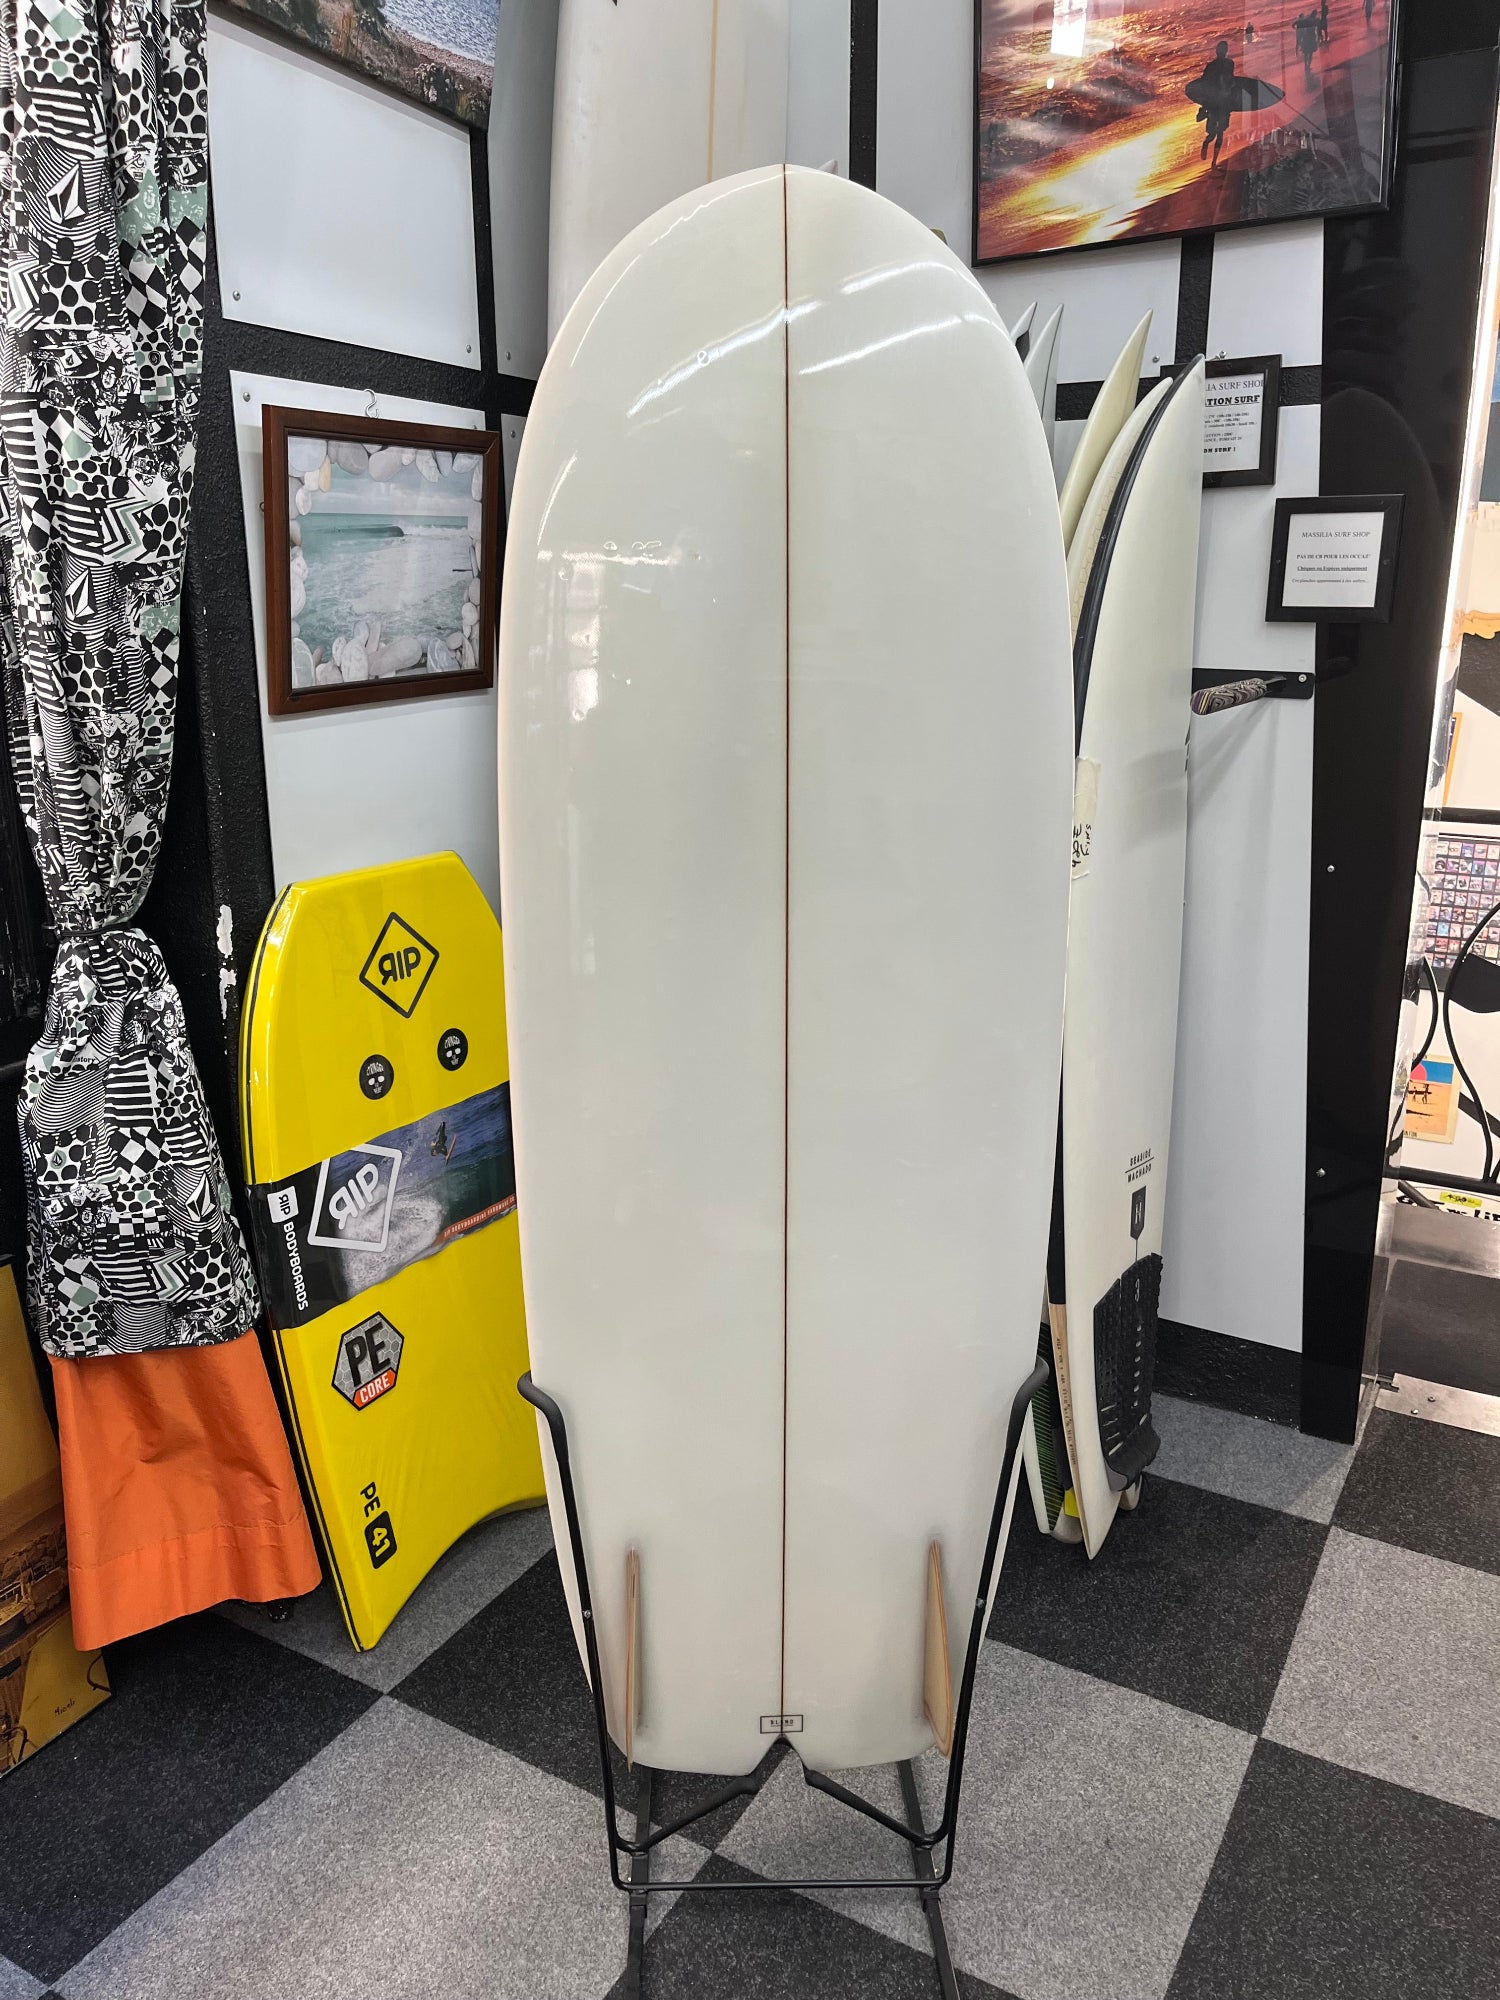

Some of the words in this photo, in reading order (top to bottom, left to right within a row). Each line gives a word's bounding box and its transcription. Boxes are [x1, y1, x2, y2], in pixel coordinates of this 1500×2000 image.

[1204, 397, 1232, 406] TION
[1234, 395, 1260, 404] SURF
[1218, 381, 1241, 391] SURF
[1127, 1163, 1152, 1183] MACHADO
[283, 1221, 309, 1311] BODYBOARDS
[345, 1321, 391, 1387] PE
[359, 1372, 391, 1403] CORE
[360, 1481, 381, 1518] PE
[372, 1526, 391, 1558] 41
